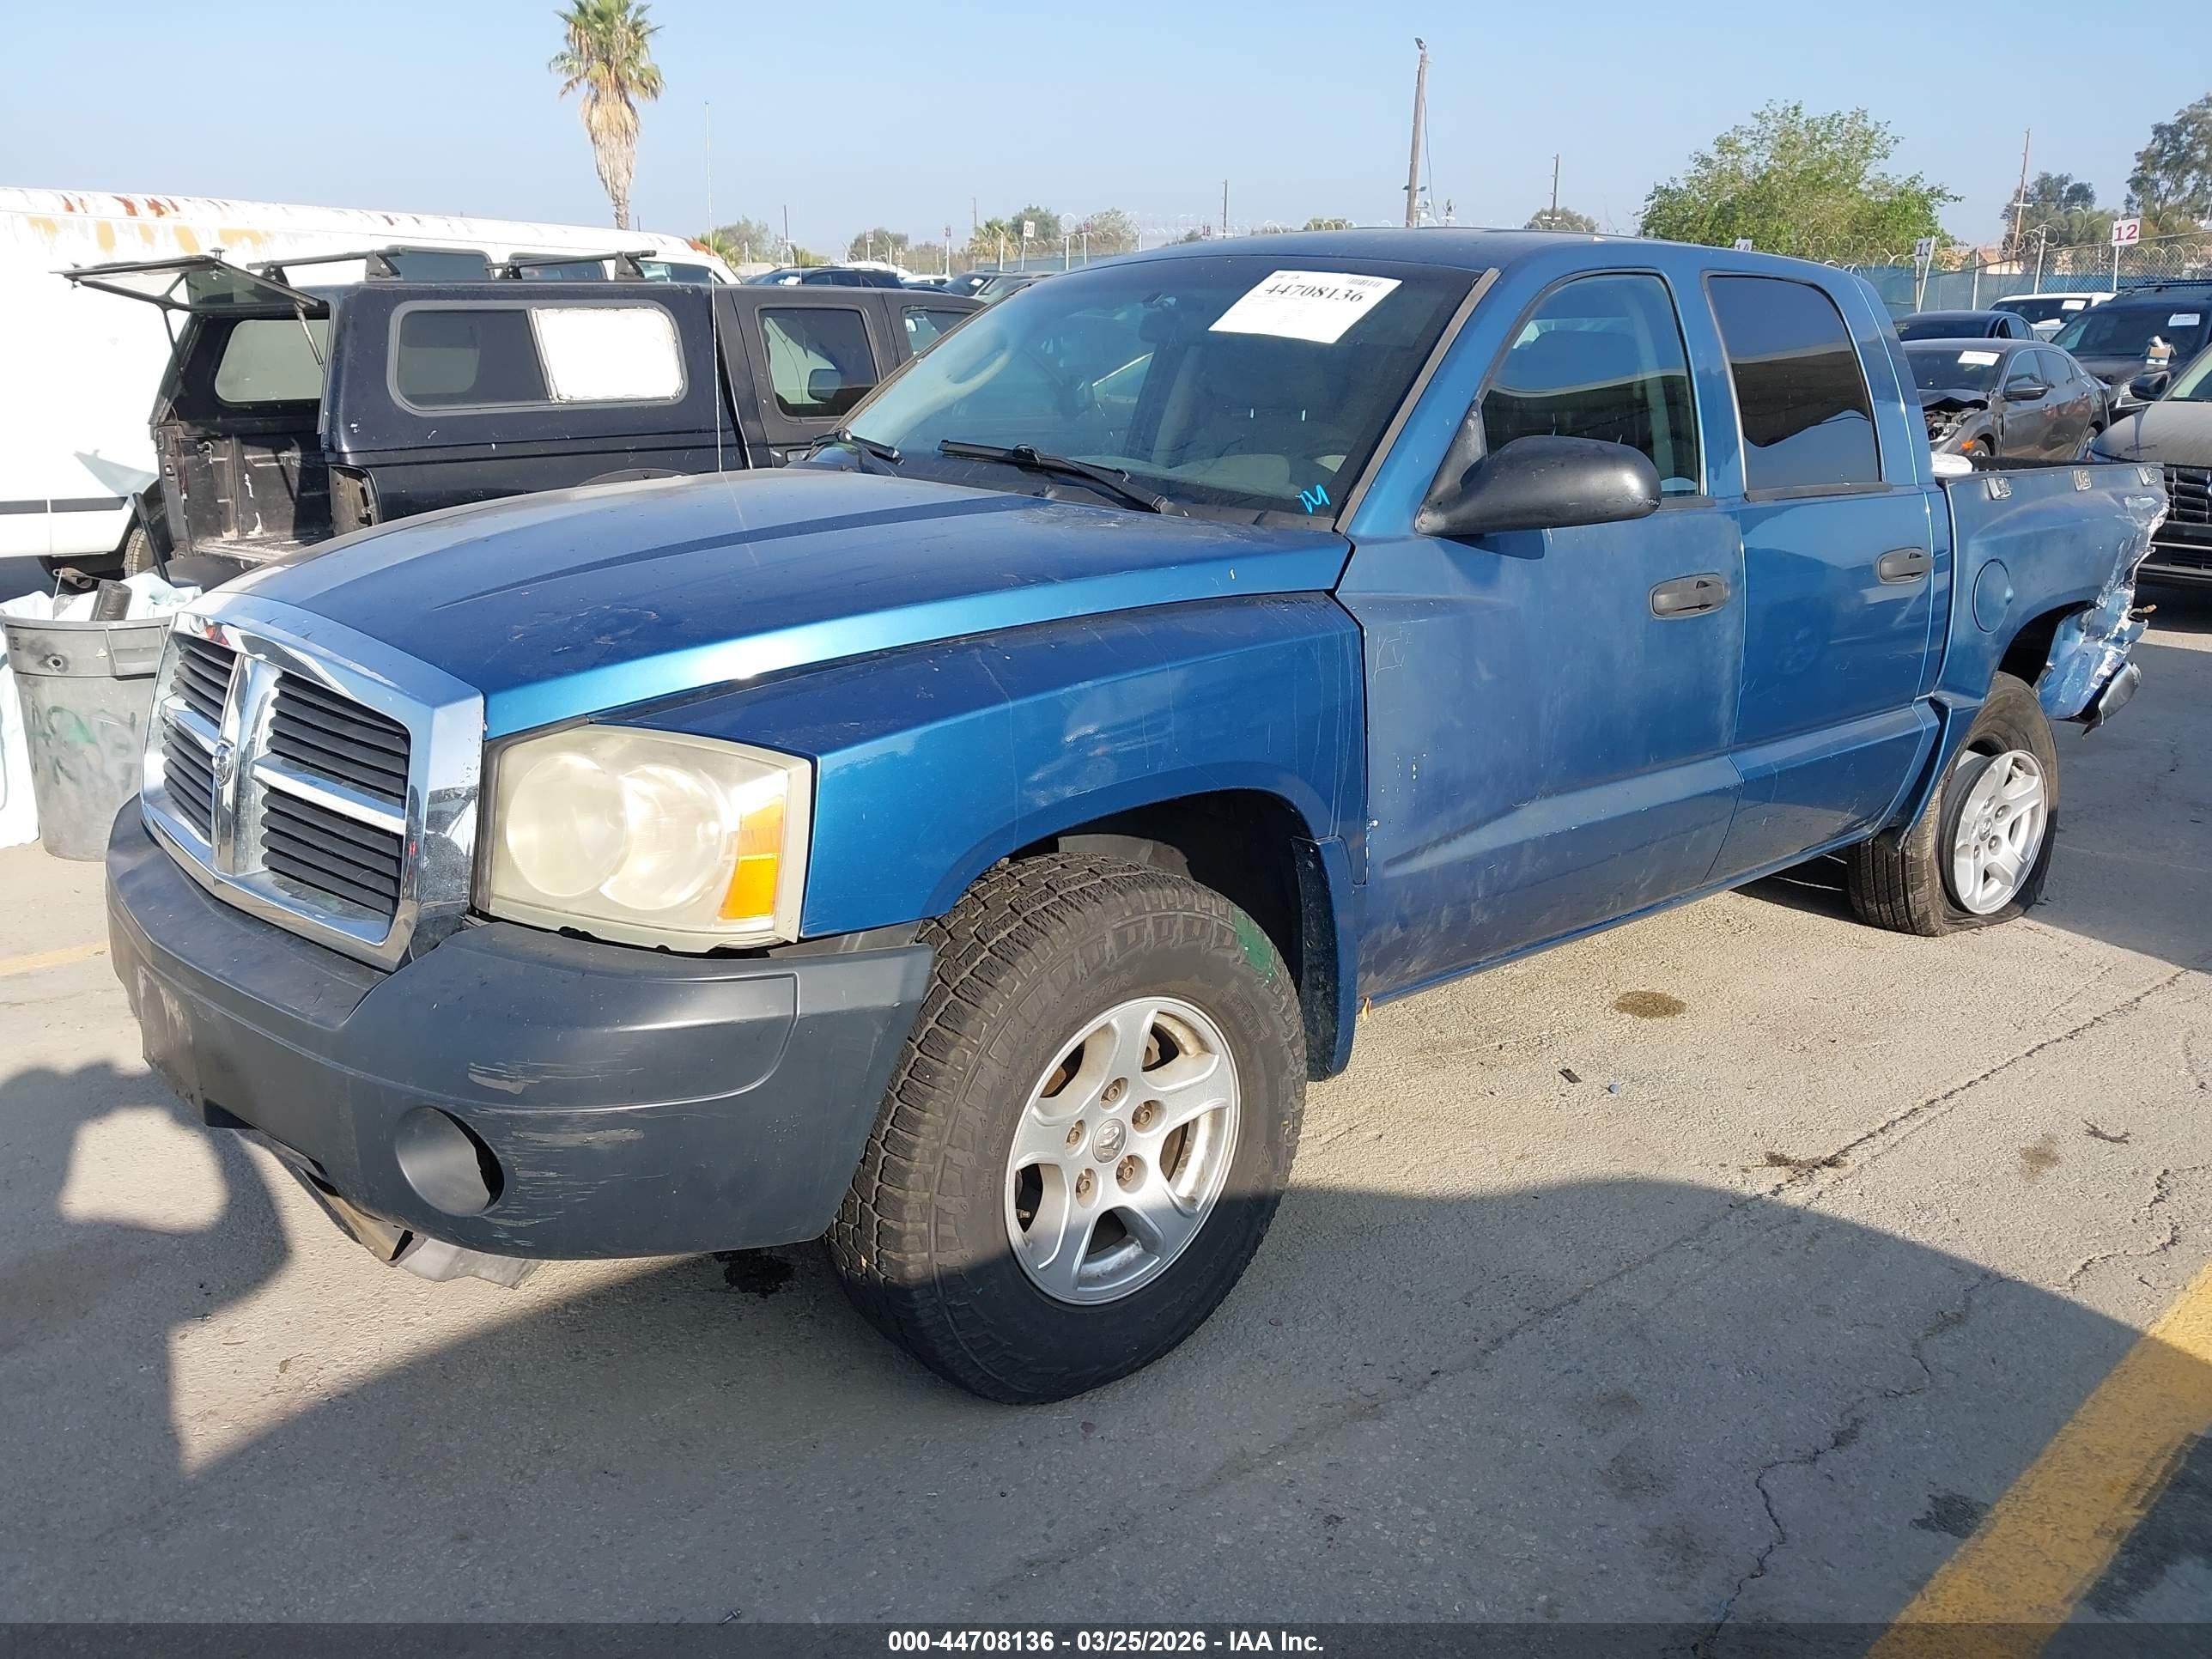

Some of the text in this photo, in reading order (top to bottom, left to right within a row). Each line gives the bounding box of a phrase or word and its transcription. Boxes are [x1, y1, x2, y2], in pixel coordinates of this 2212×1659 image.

[1024, 224, 1034, 234] 20
[2114, 224, 2138, 241] 12
[1265, 283, 1365, 302] 44708136
